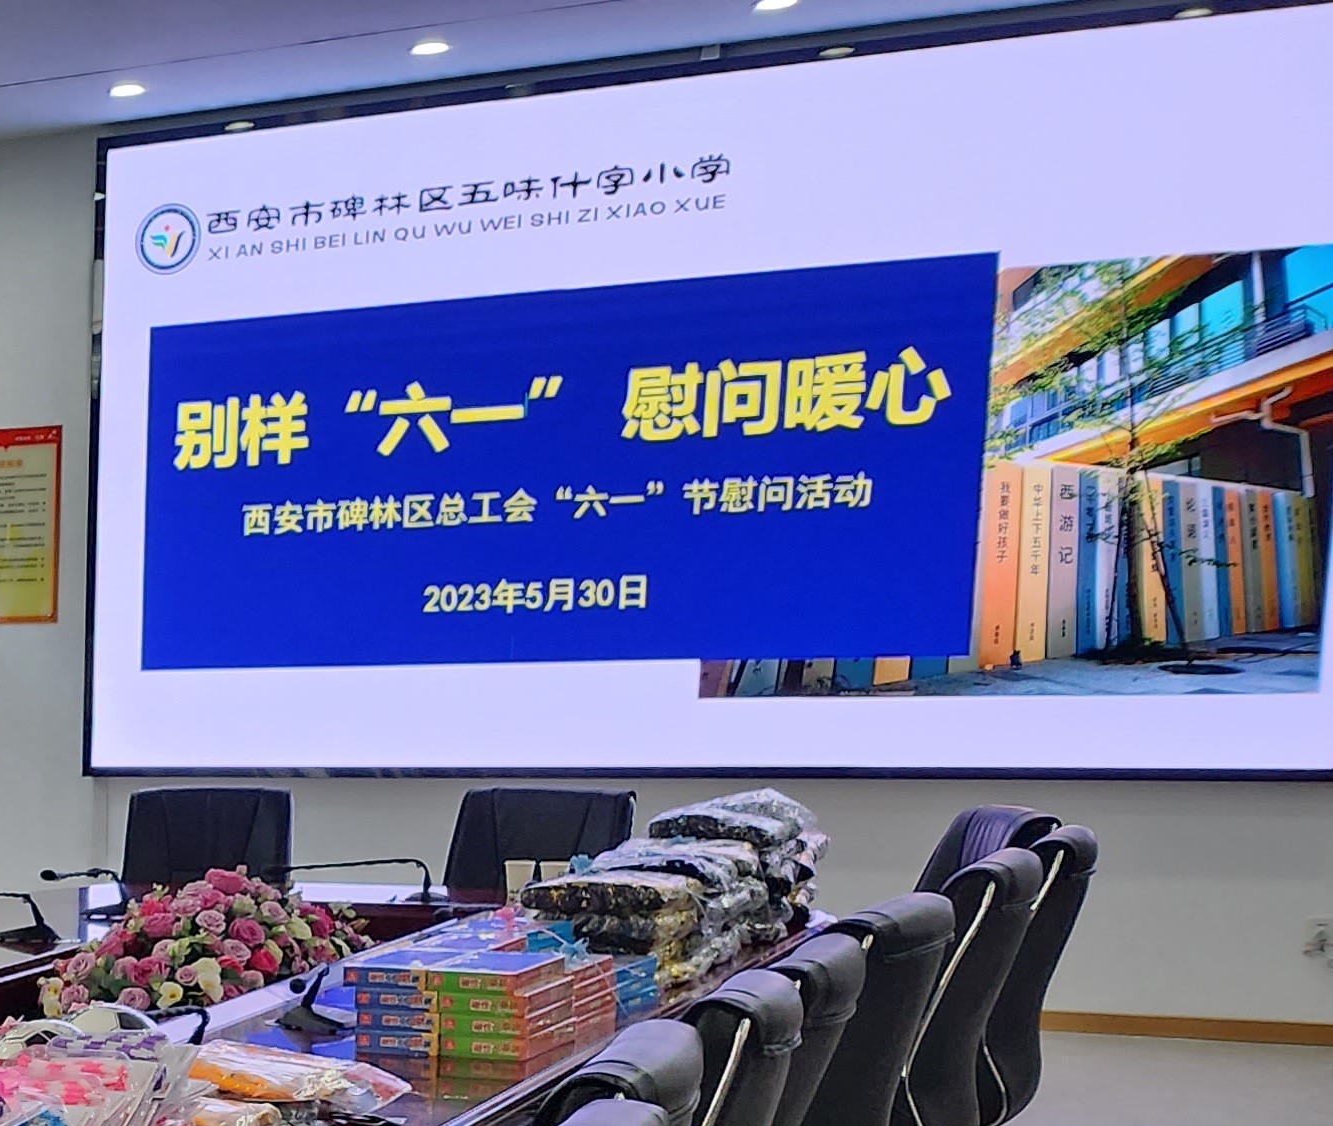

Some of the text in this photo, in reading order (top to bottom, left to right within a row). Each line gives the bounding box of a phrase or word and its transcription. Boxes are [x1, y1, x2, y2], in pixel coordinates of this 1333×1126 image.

[206, 154, 731, 235] 西安市碑林区五味什字小学
[207, 194, 727, 261] XI AN SHI BEI LIN QU WU WEI SHI ZI XIAO XUE
[621, 345, 953, 442] 慰问暖心
[996, 481, 1011, 563] 我要做好孩子
[1029, 483, 1044, 576] 中华上下五千年
[1058, 483, 1075, 565] 西游记
[422, 573, 649, 614] 2023年5月30日
